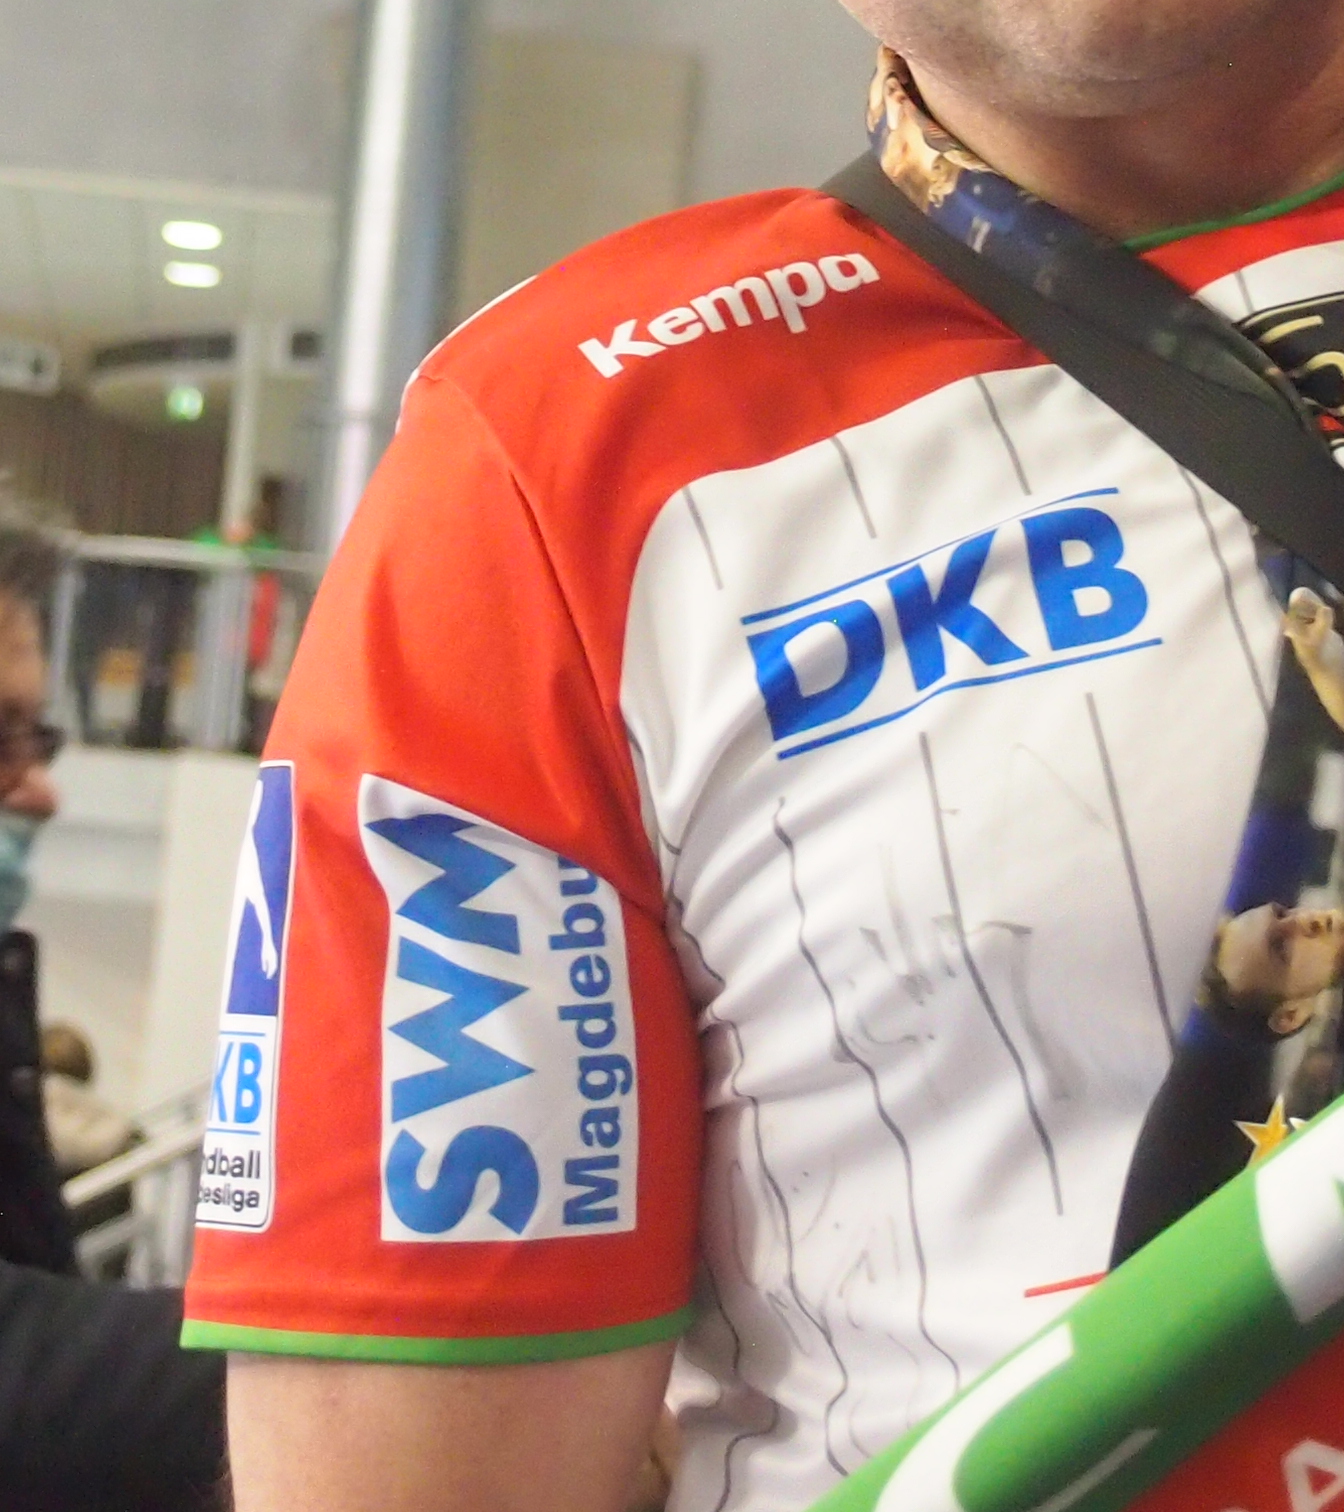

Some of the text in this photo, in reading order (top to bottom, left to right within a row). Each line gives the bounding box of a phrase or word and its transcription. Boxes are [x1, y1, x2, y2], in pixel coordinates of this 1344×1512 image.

[577, 252, 881, 379] Kempa
[746, 506, 1149, 742] DKB
[384, 813, 541, 1236] SWM
[199, 1183, 261, 1213] esliga
[203, 1147, 261, 1180] dball
